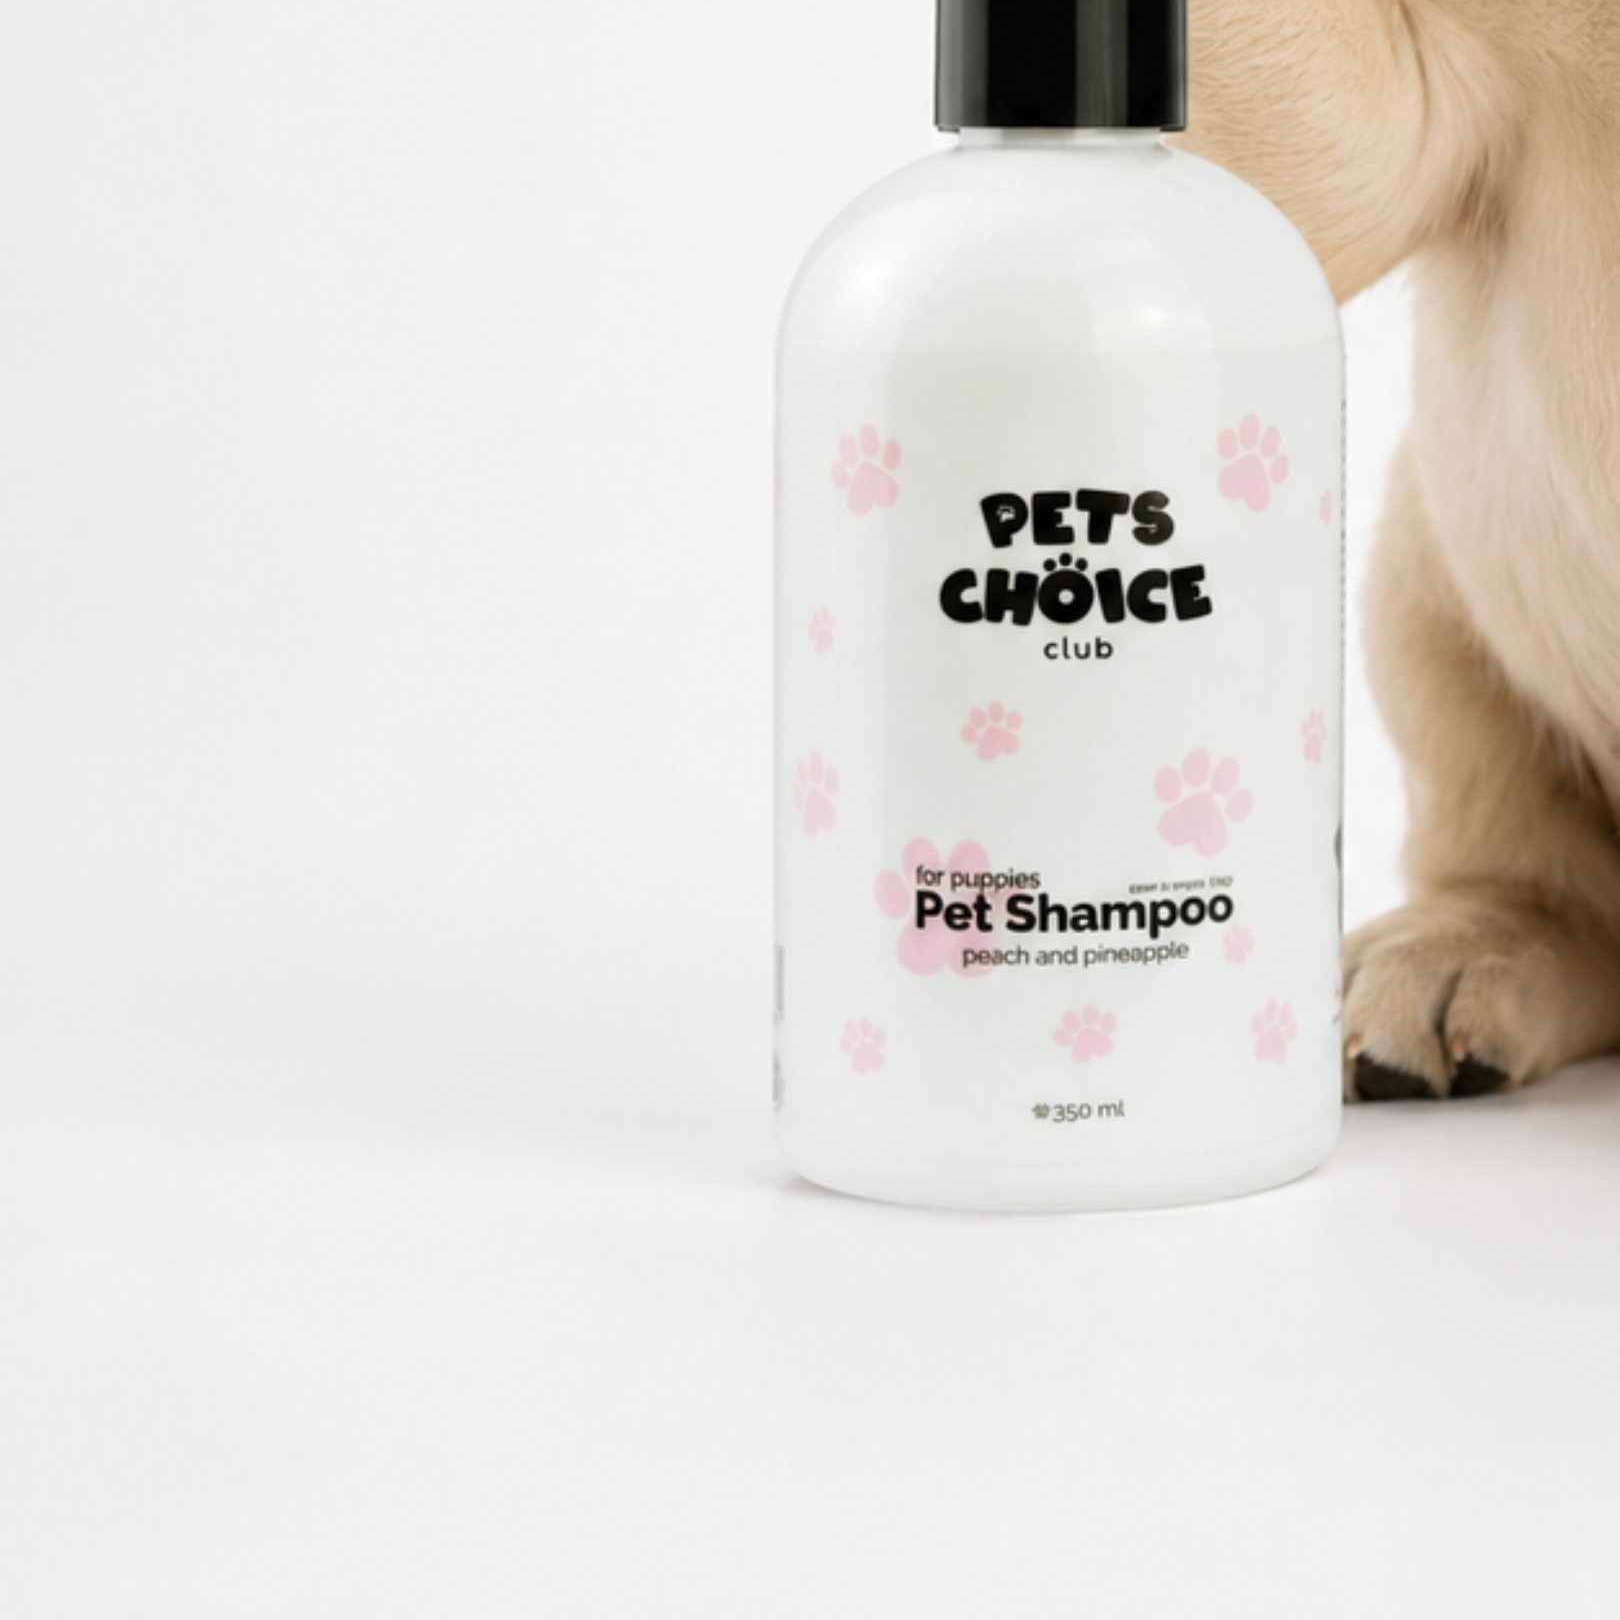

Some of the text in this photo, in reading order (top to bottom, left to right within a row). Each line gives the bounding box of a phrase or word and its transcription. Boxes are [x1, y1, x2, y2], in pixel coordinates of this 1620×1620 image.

[979, 487, 1175, 549] PETS
[938, 563, 1213, 627] CHOICE
[1043, 636, 1114, 660] club
[916, 865, 1041, 893] for puppies
[915, 889, 1234, 940] Pet Shampoo
[962, 940, 1190, 969] peach and pineapple
[1053, 1097, 1125, 1123] 350 ml
